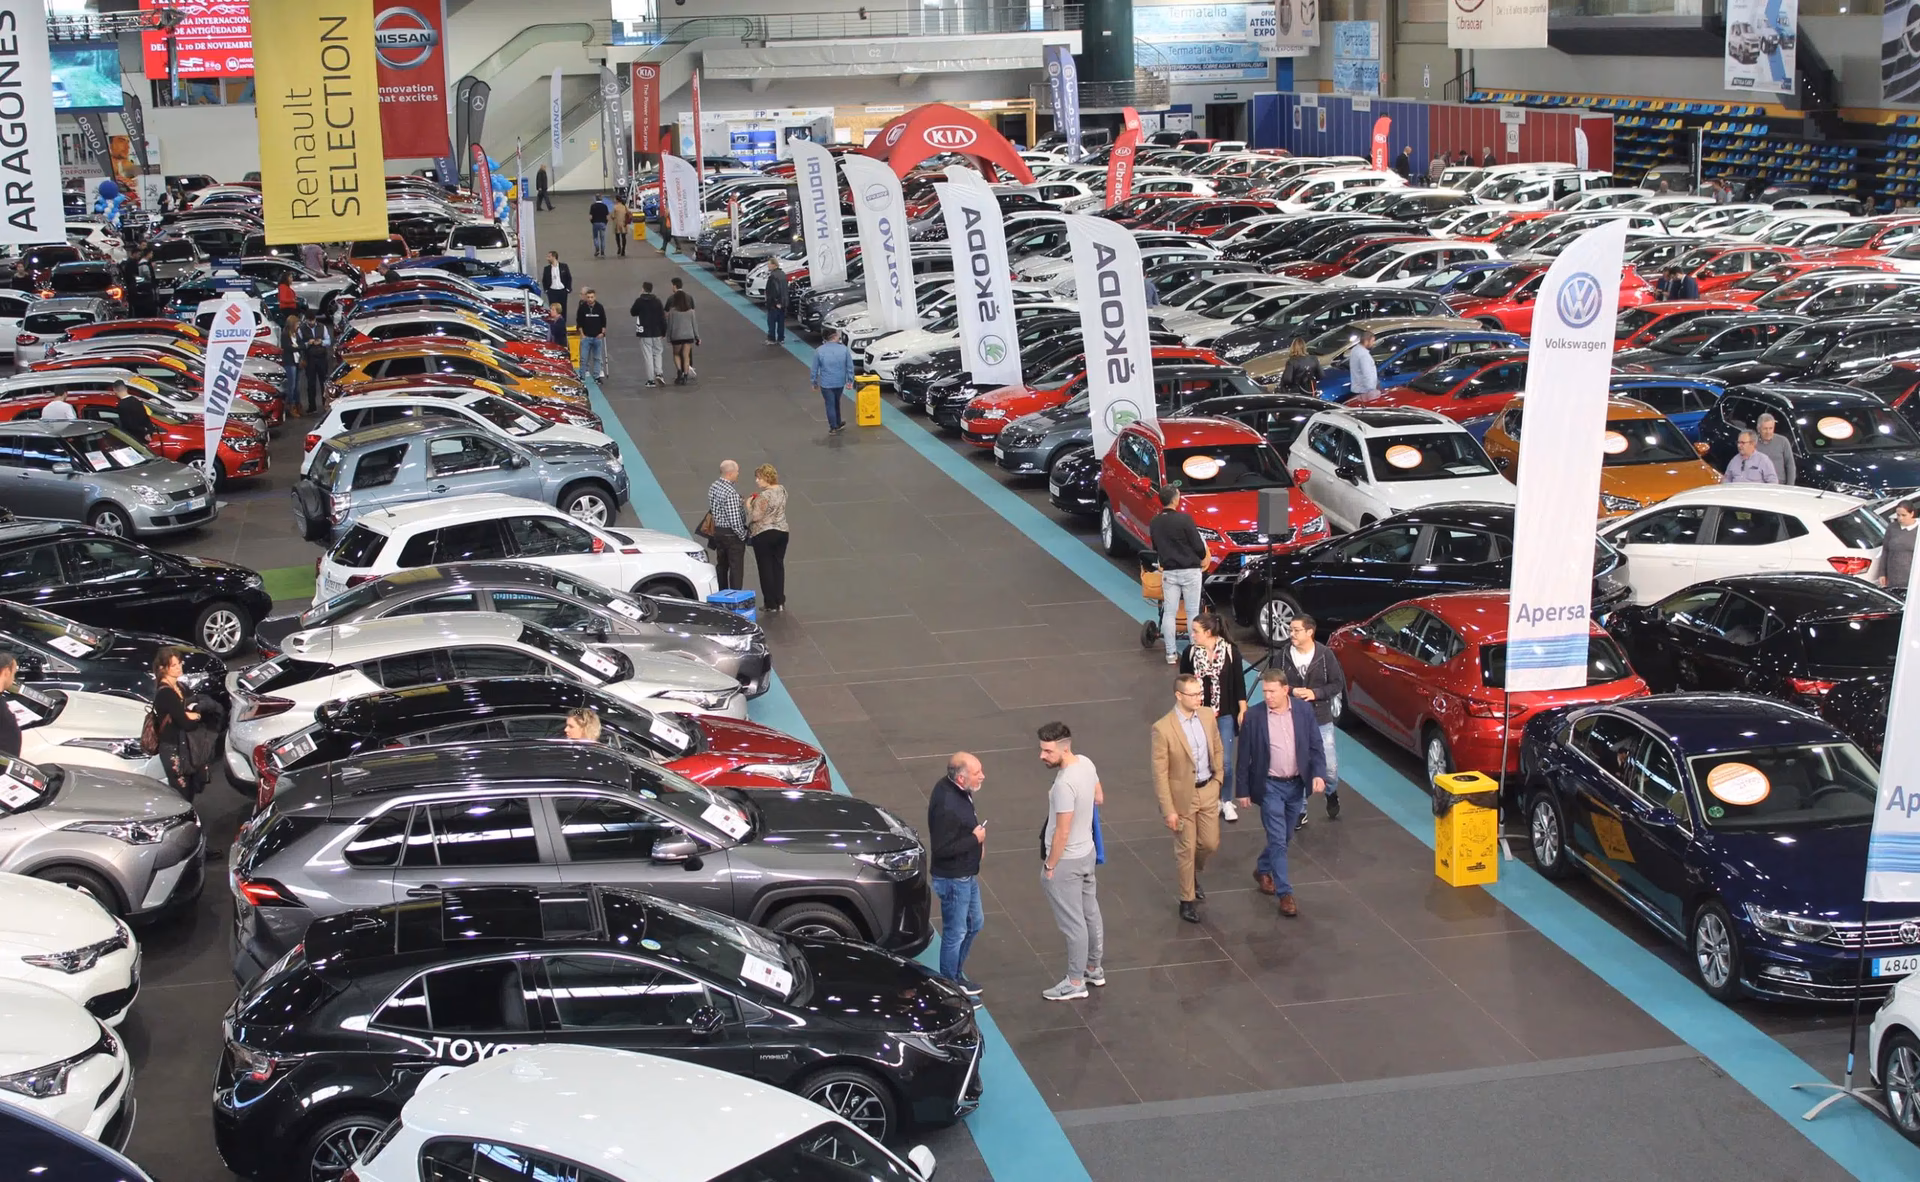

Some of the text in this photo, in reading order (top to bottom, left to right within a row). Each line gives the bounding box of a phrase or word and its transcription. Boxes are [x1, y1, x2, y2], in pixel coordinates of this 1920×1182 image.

[1169, 6, 1227, 18] Termatalia
[186, 26, 247, 34] ANTIGÜEDADES
[375, 33, 431, 43] NISSAN
[868, 49, 881, 57] C2
[1168, 45, 1212, 55] Termatalia
[639, 68, 652, 76] KIA
[378, 84, 434, 93] nnovation
[378, 93, 438, 102] hat excites
[319, 16, 361, 217] SELECTION
[611, 101, 626, 185] Cibrauto
[932, 131, 970, 144] KIA
[283, 88, 321, 220] Renault
[215, 329, 251, 338] SUZUKI
[1545, 338, 1607, 352] Volkswagen
[206, 346, 245, 417] VIPER
[1516, 603, 1585, 627] Apersa
[1884, 957, 1918, 972] 4840
